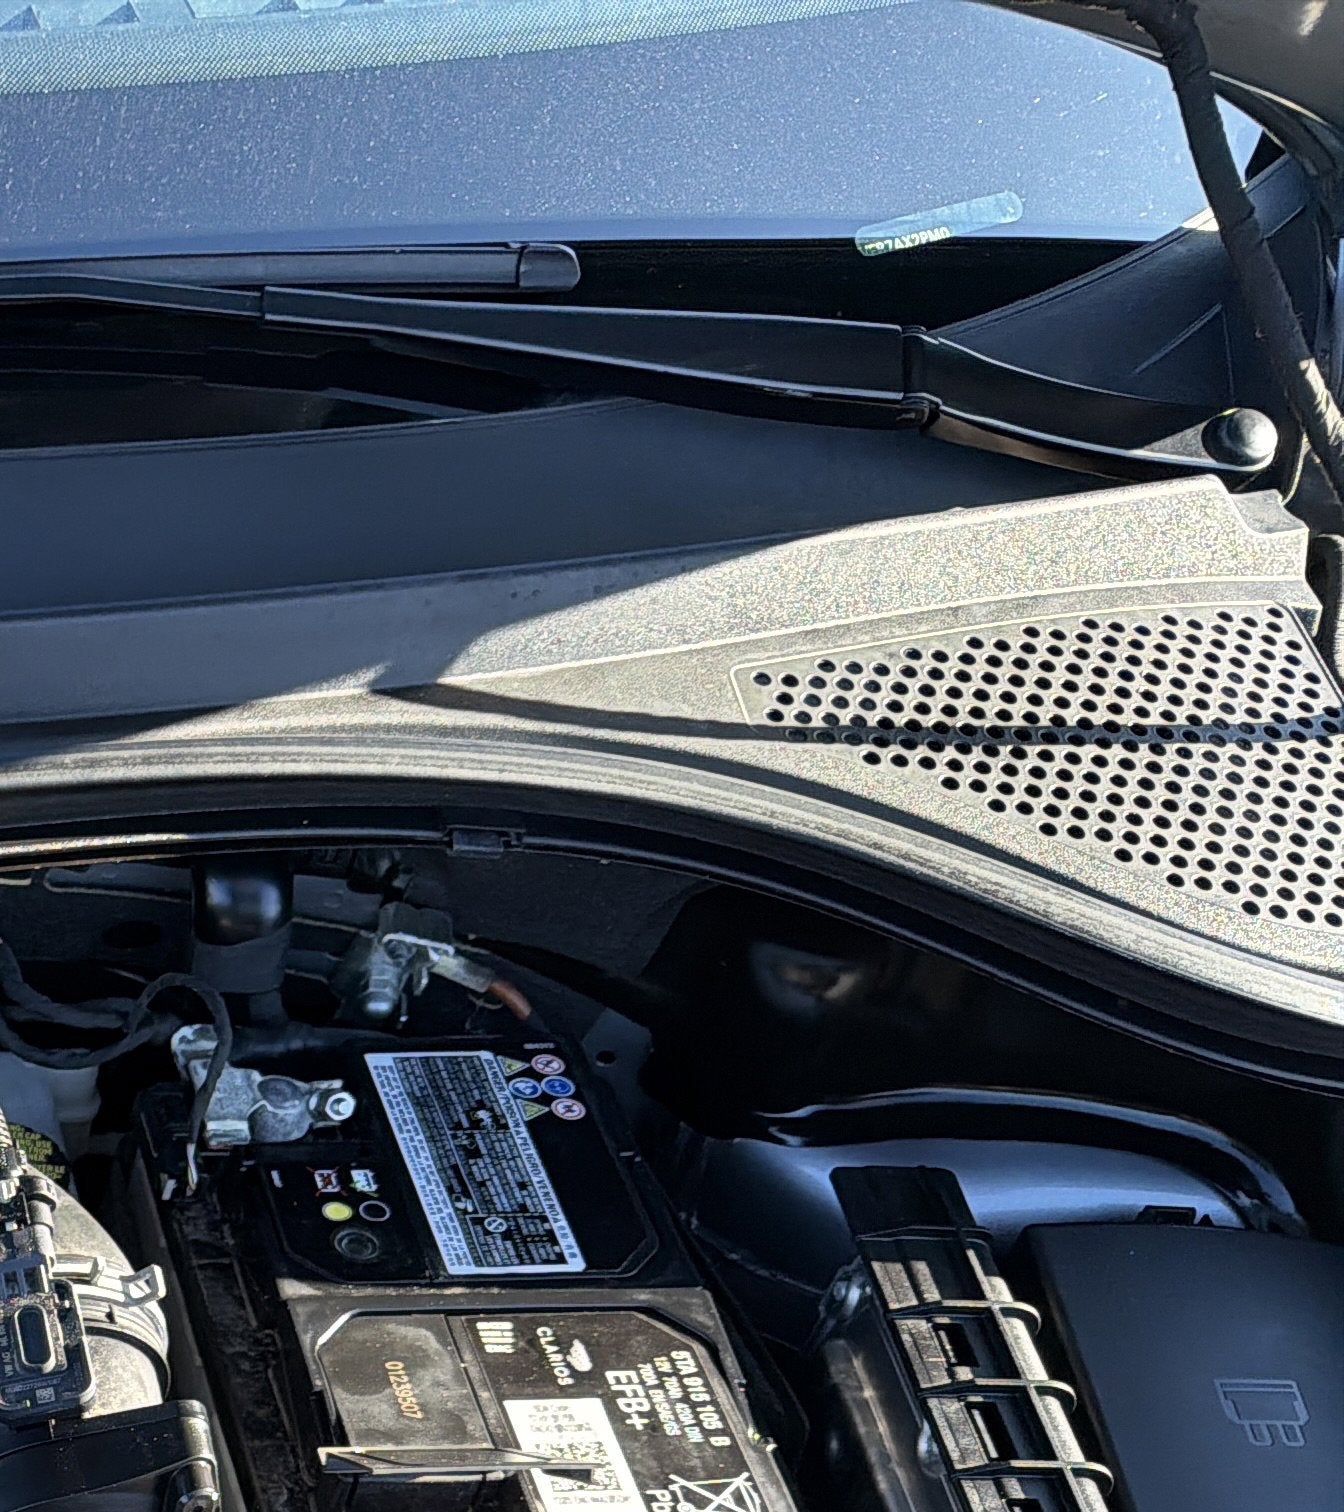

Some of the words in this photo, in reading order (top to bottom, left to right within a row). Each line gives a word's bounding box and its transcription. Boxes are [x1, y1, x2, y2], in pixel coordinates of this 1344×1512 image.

[536, 1326, 575, 1386] CLARIOS
[384, 1361, 424, 1419] 01239507
[604, 1370, 650, 1430] EFB+
